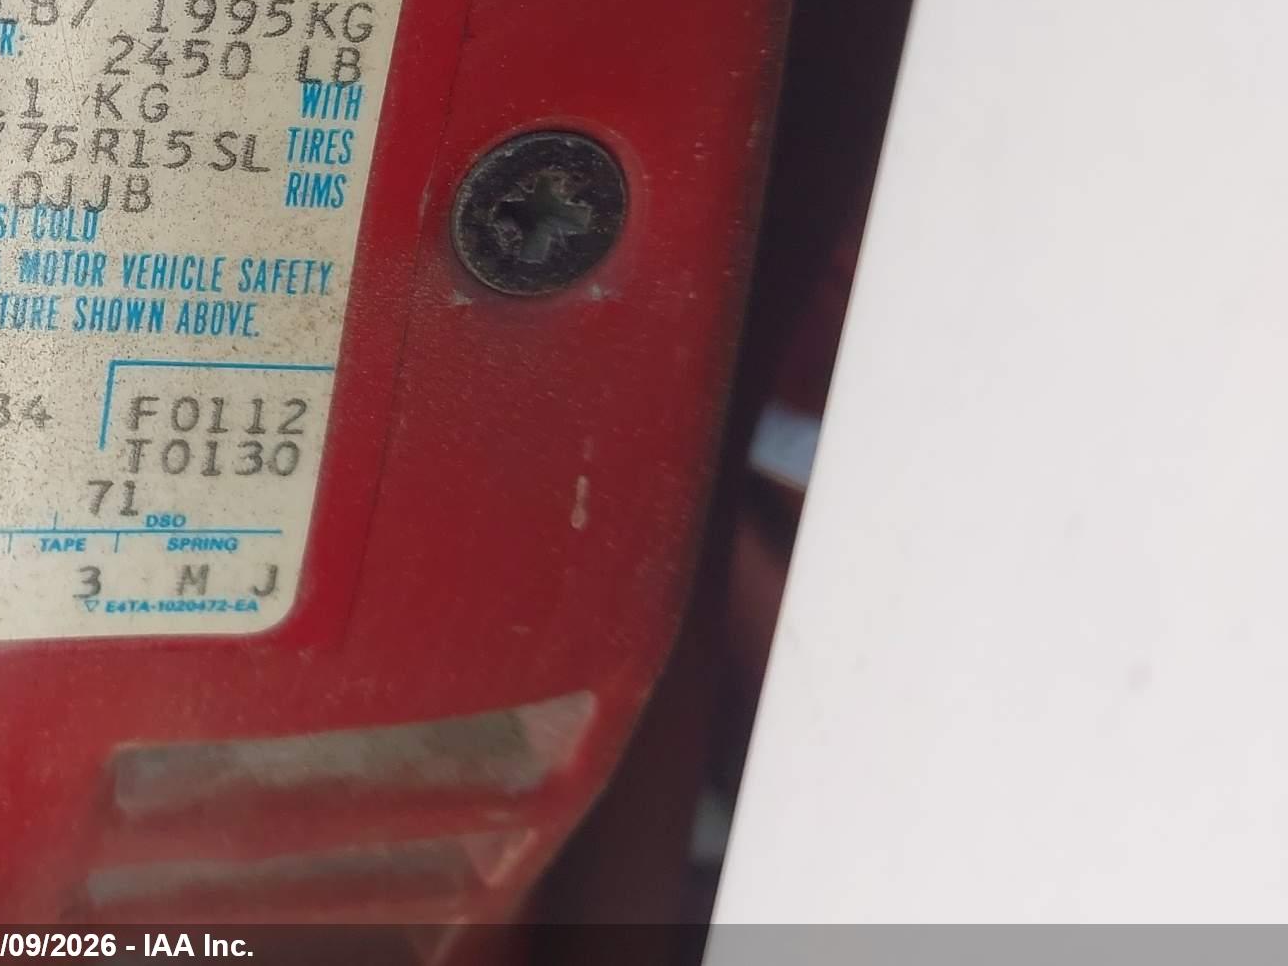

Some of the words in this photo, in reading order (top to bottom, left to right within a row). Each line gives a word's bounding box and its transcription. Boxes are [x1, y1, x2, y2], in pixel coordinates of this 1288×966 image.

[102, 34, 252, 81] 2450
[295, 44, 363, 87] LB
[91, 82, 171, 124] KG
[299, 81, 363, 122] WITH
[285, 126, 354, 165] TIRES
[284, 171, 346, 209] RIMS
[33, 202, 101, 243] COLD
[18, 249, 108, 287] MOTOR
[120, 255, 224, 293] VEHICLE
[239, 257, 334, 297] SAFETY
[74, 297, 165, 333] SHOWN
[175, 300, 261, 338] ABOVE.
[86, 479, 139, 517] 71
[145, 514, 187, 528] DSO
[40, 537, 87, 552] TAPE
[167, 537, 239, 552] SPRING
[72, 565, 102, 599] 3
[176, 564, 209, 596] M
[252, 564, 279, 597] J
